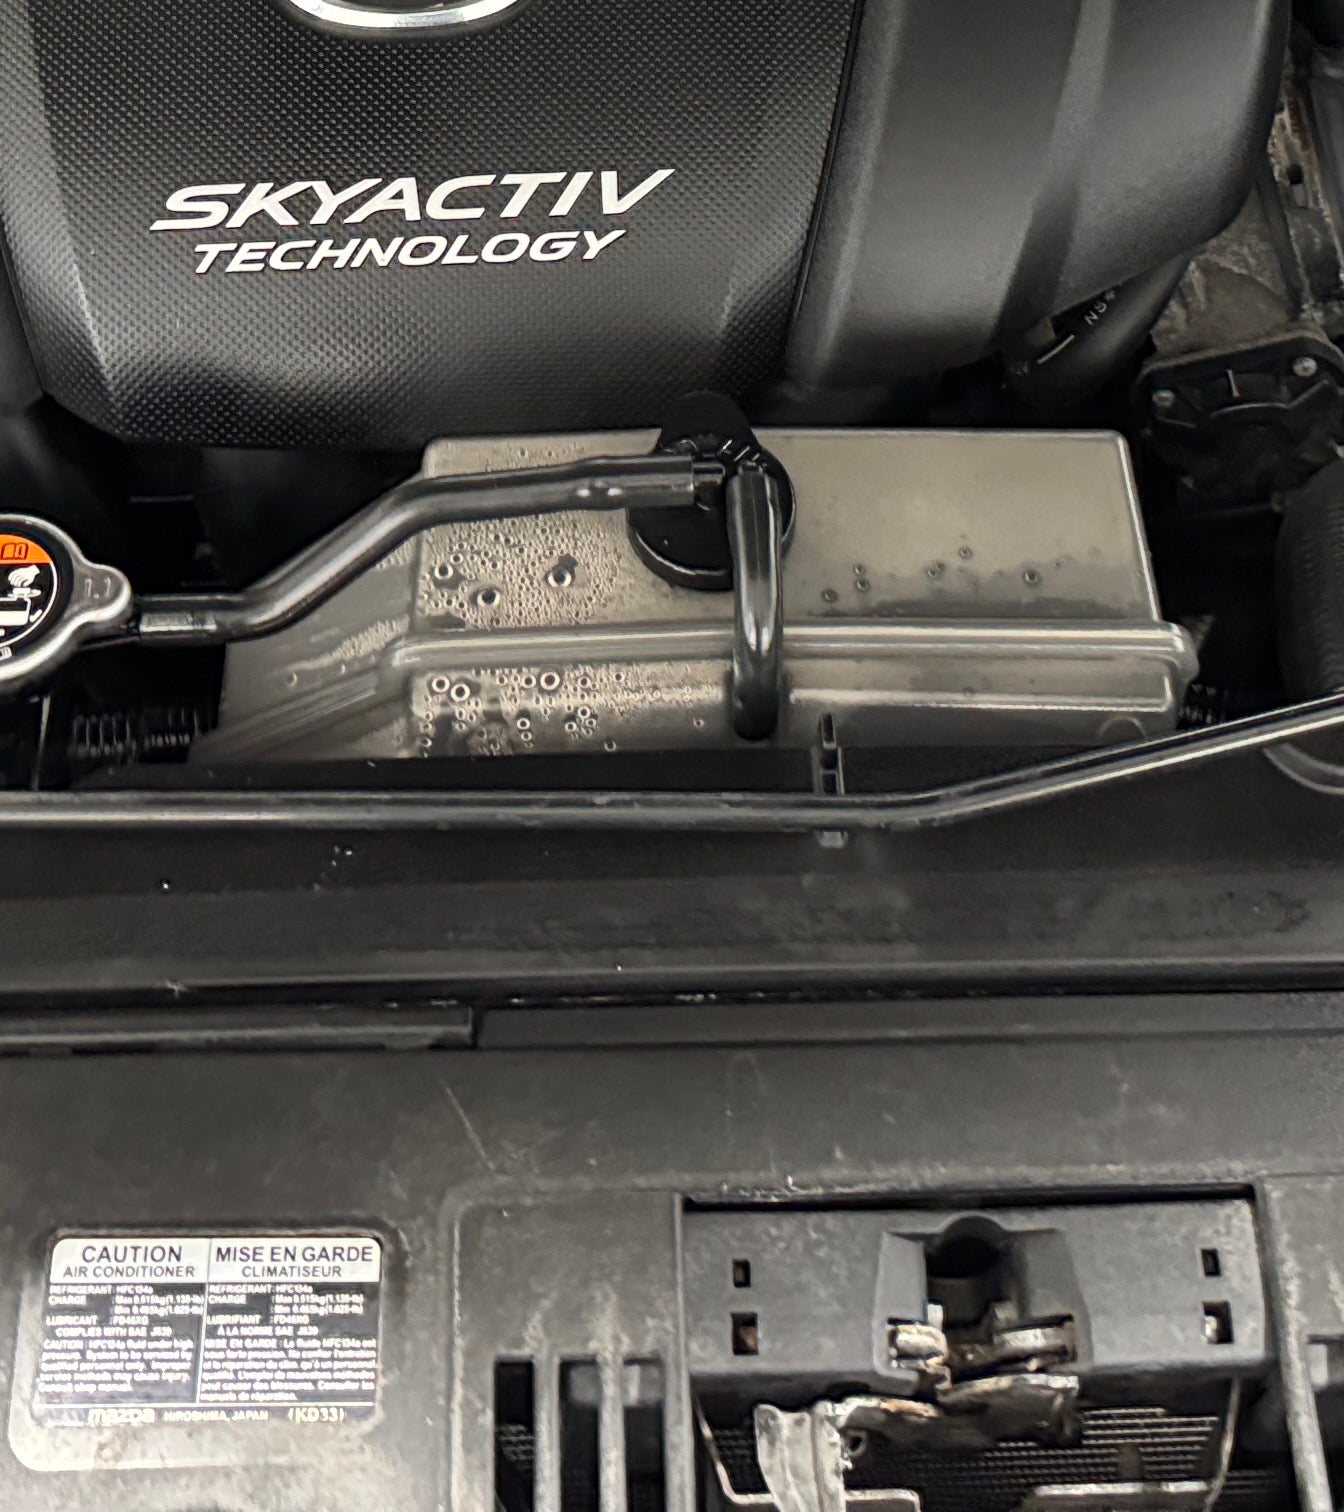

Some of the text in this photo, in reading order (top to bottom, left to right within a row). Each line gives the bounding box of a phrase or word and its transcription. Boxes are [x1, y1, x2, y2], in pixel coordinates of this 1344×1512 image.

[150, 168, 675, 231] SKYACTIV
[195, 230, 626, 274] TECHNOLOGY
[81, 1245, 183, 1263] CAUTION
[215, 1245, 373, 1262] MISE EN GARDE
[63, 1265, 195, 1278] AIR CONDITIONER
[242, 1266, 342, 1278] CLIMATISEUR
[48, 1295, 86, 1305] CHARGE
[209, 1294, 247, 1304] CHARGE
[231, 1410, 269, 1422] JAPAN
[288, 1407, 344, 1423] (KD33)
